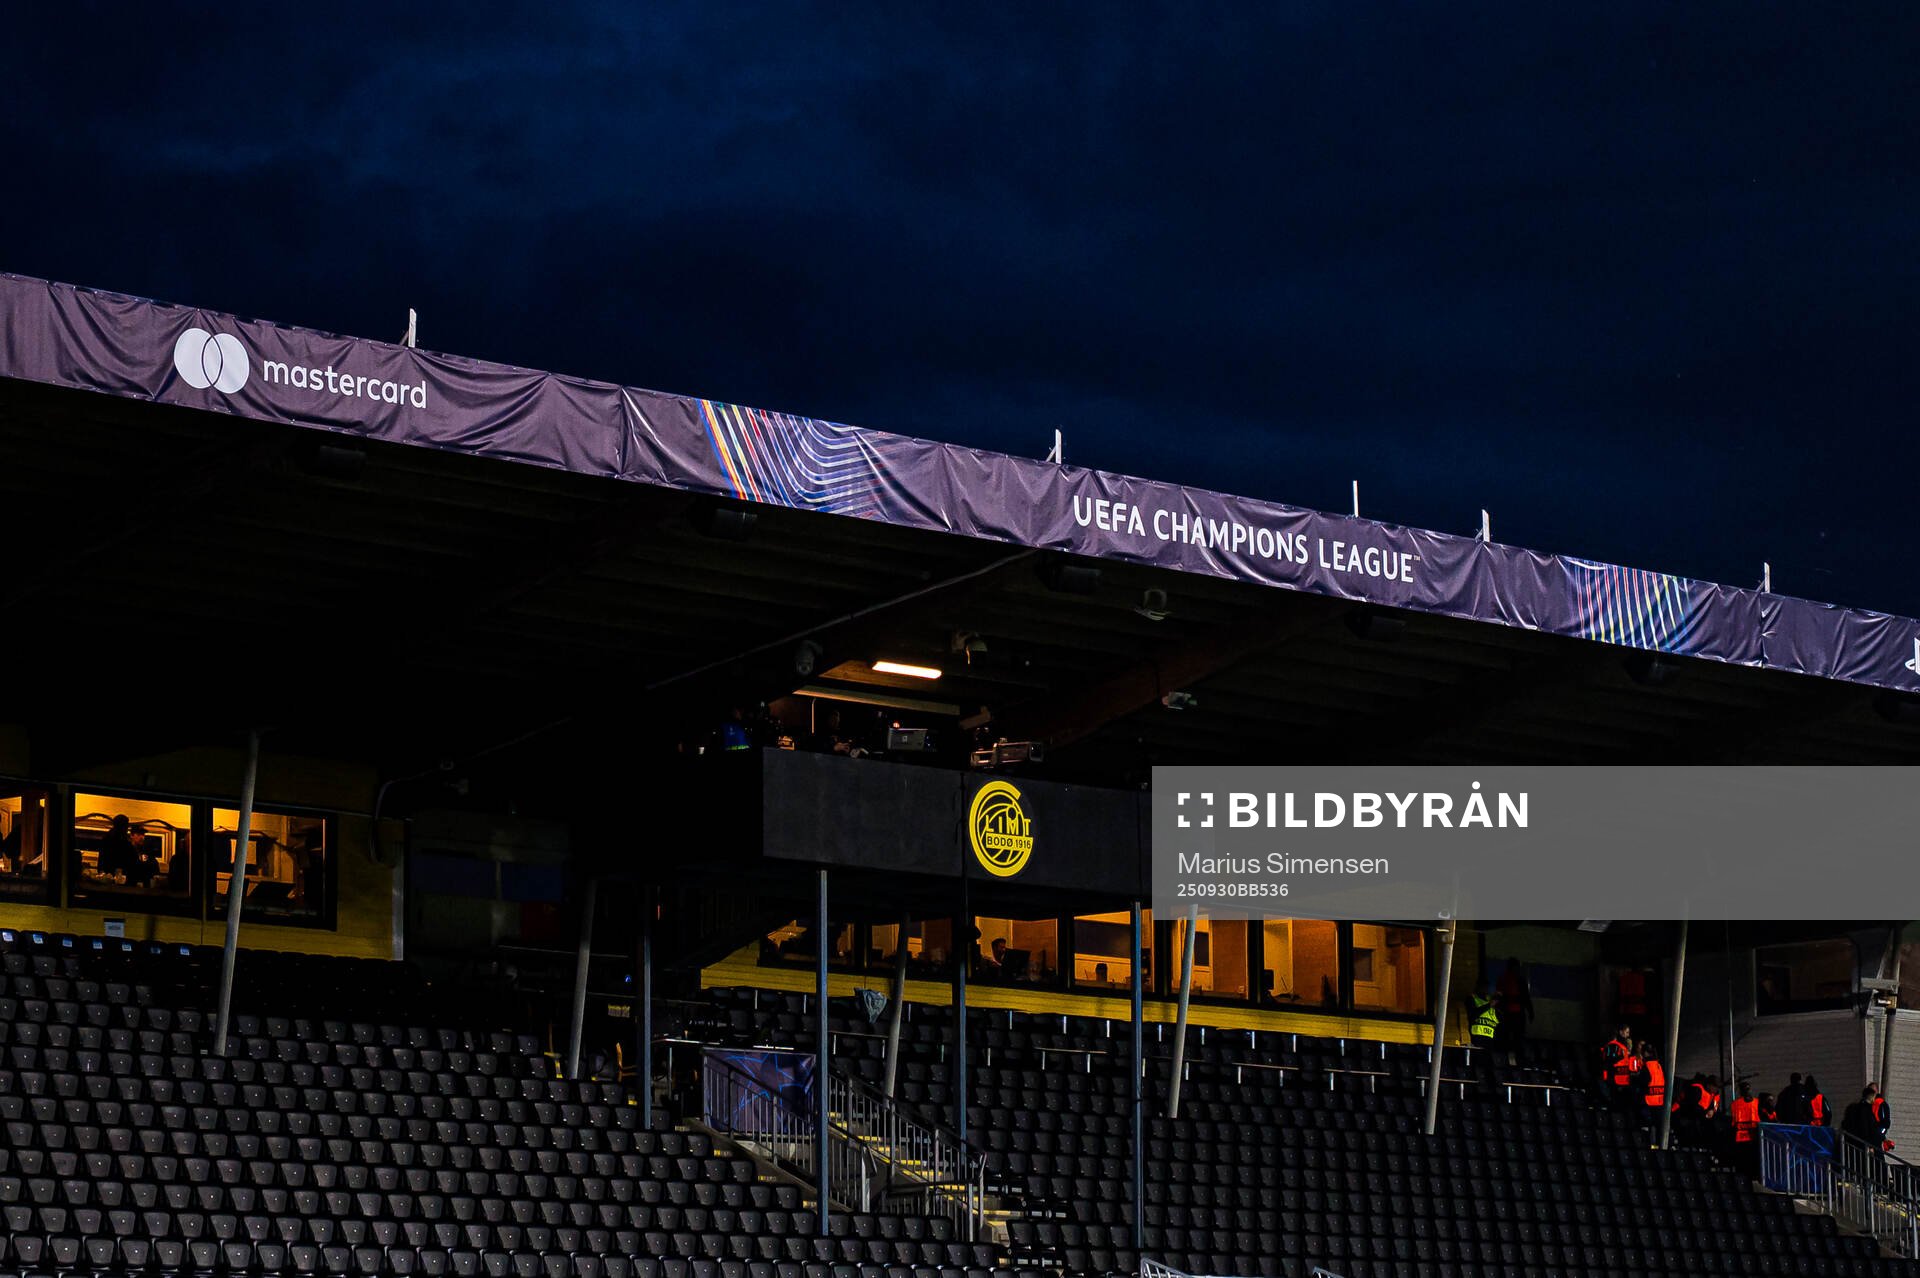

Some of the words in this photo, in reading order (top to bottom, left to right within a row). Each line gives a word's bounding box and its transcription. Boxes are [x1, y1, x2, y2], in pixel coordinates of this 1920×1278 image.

[263, 359, 427, 408] mastercard
[1073, 495, 1146, 537] UEFA
[1153, 509, 1309, 564] CHAMPIONS
[986, 836, 1013, 847] BODØ
[1015, 839, 1031, 849] 1916
